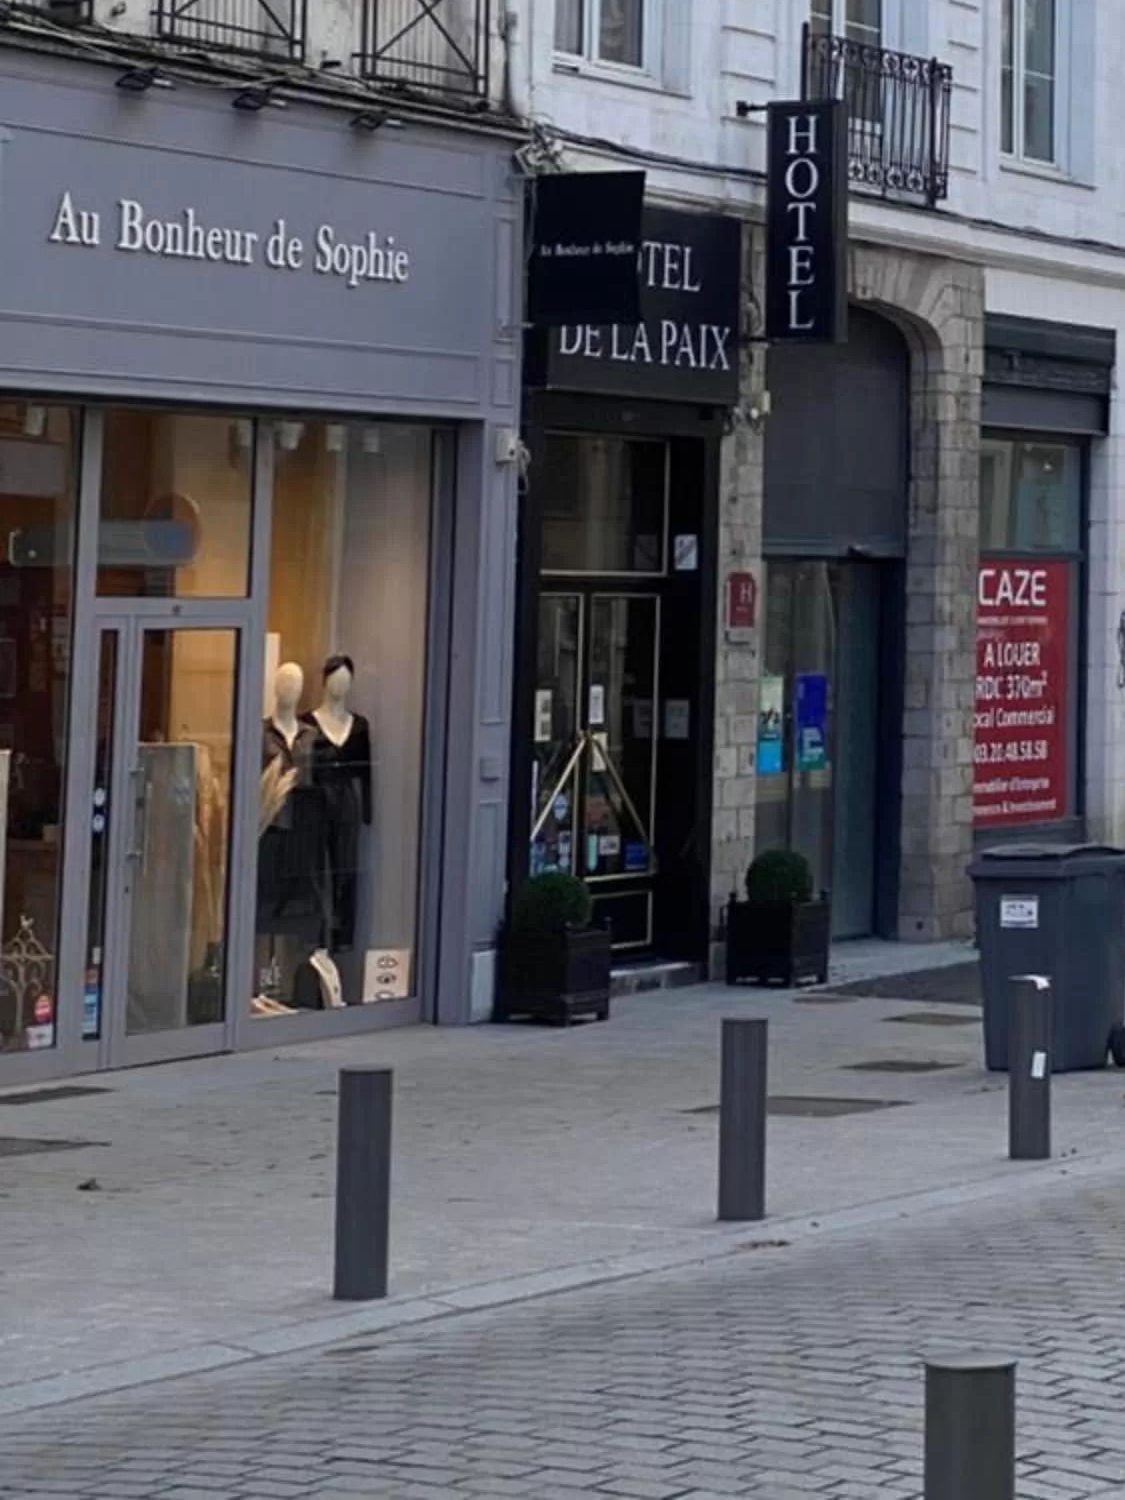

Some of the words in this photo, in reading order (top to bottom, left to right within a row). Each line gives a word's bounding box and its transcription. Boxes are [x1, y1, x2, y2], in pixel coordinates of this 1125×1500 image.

[49, 192, 99, 246] Au
[117, 199, 258, 265] Bonheur
[266, 219, 303, 269] de
[315, 224, 409, 288] Sophie
[786, 114, 819, 329] HOTEL
[638, 241, 700, 292] TEL
[559, 323, 602, 358] DE
[611, 322, 652, 363] LA
[660, 319, 732, 372] PAIX
[978, 569, 1047, 607] CAZE
[983, 643, 995, 669] A
[997, 641, 1041, 668] LOUER
[971, 706, 995, 730] ocal
